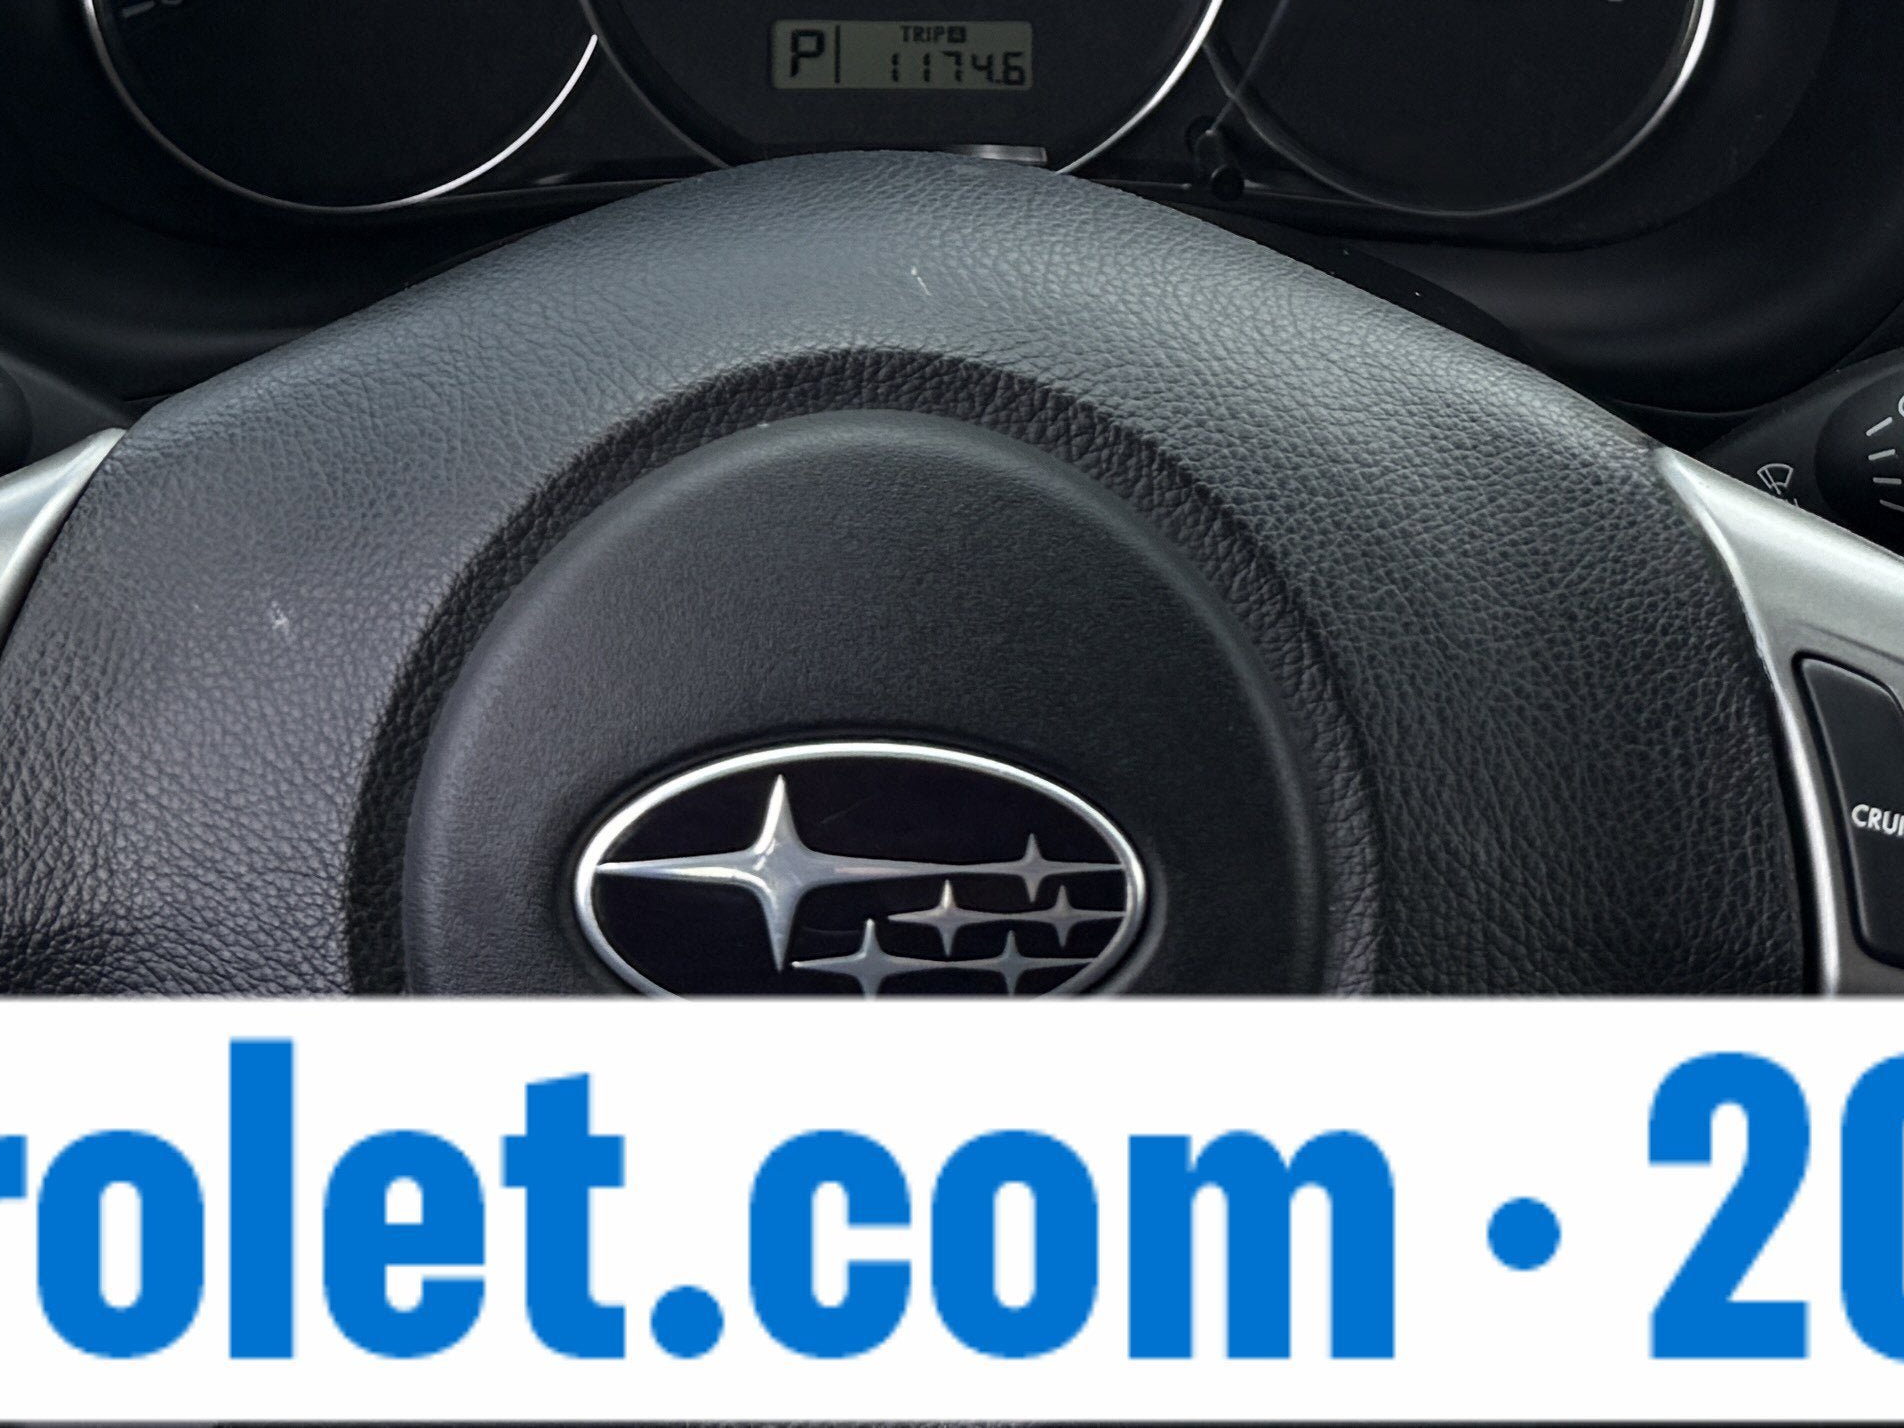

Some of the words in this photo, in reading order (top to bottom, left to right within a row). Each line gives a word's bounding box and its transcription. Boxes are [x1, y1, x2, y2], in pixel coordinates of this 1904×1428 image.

[900, 25, 945, 44] TRIP
[790, 30, 826, 78] P
[891, 51, 1025, 86] 1174.6
